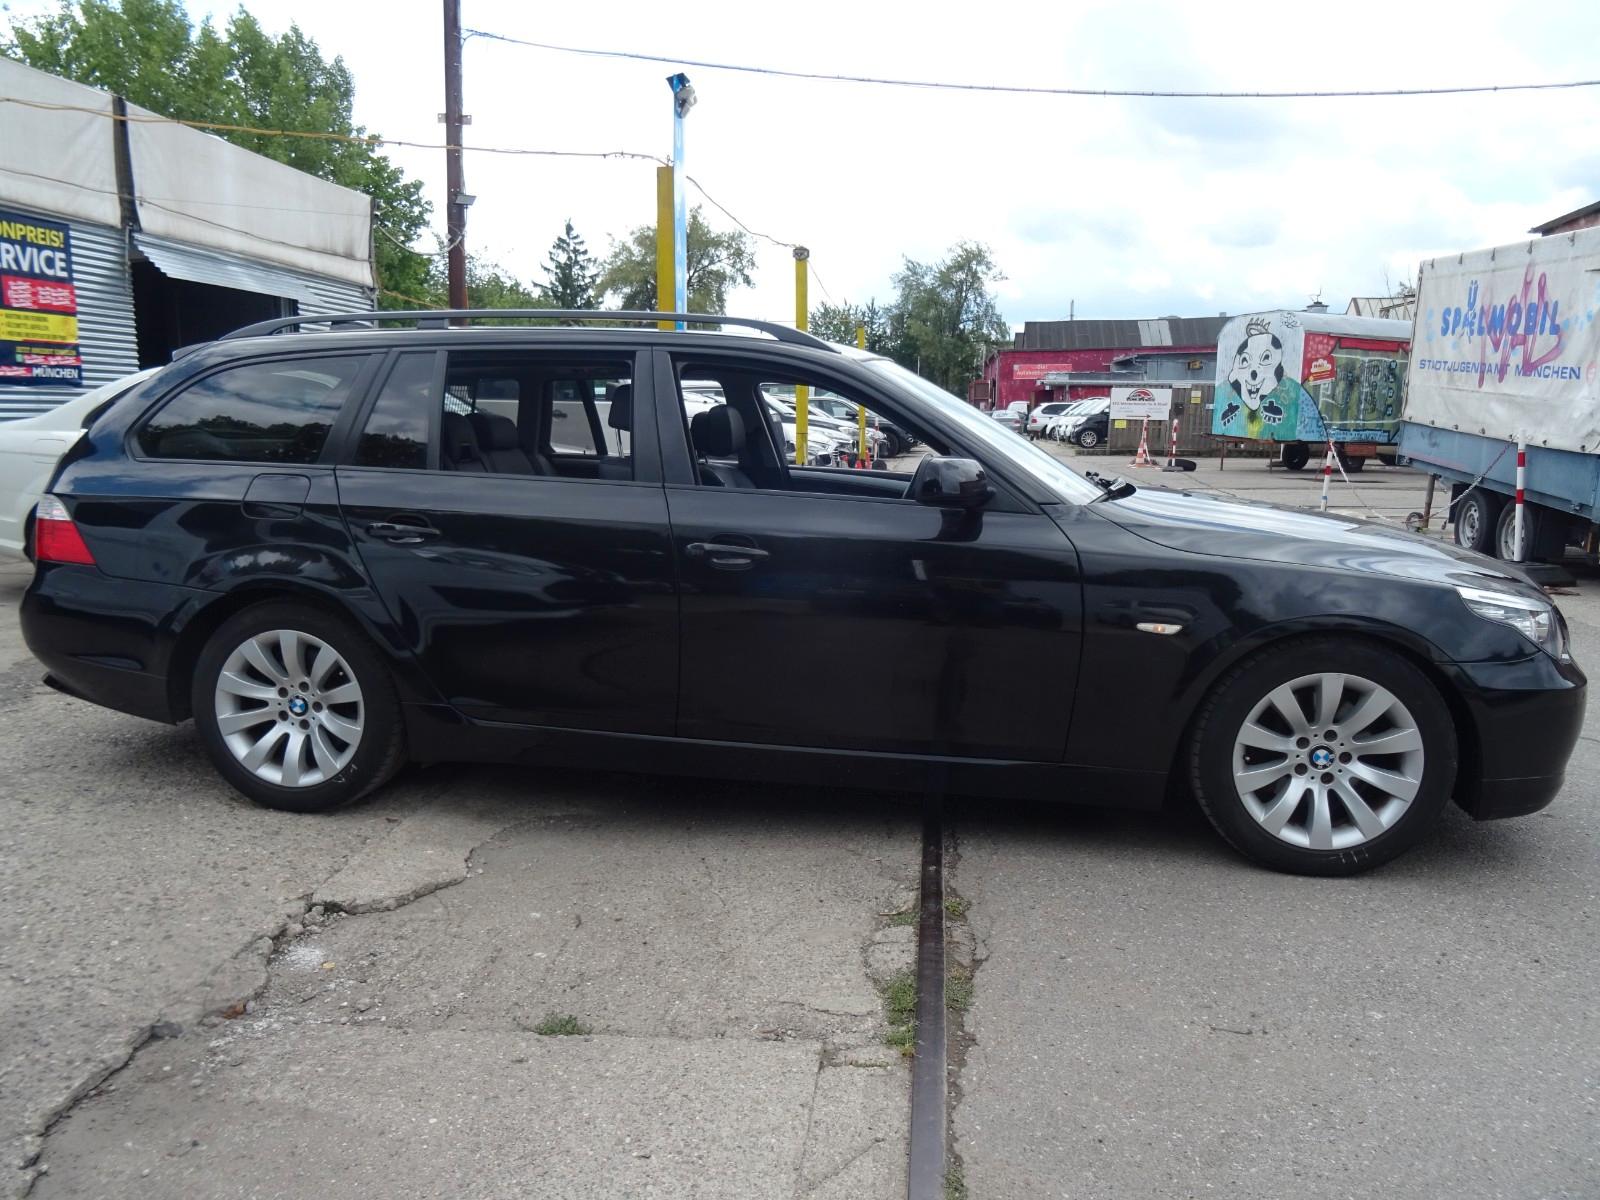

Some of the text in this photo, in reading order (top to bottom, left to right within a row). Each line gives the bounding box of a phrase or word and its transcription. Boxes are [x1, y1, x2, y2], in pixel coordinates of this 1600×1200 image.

[0, 220, 64, 248] NPREIS!
[0, 242, 68, 277] RVICE
[32, 365, 79, 378] MÜNCHEN
